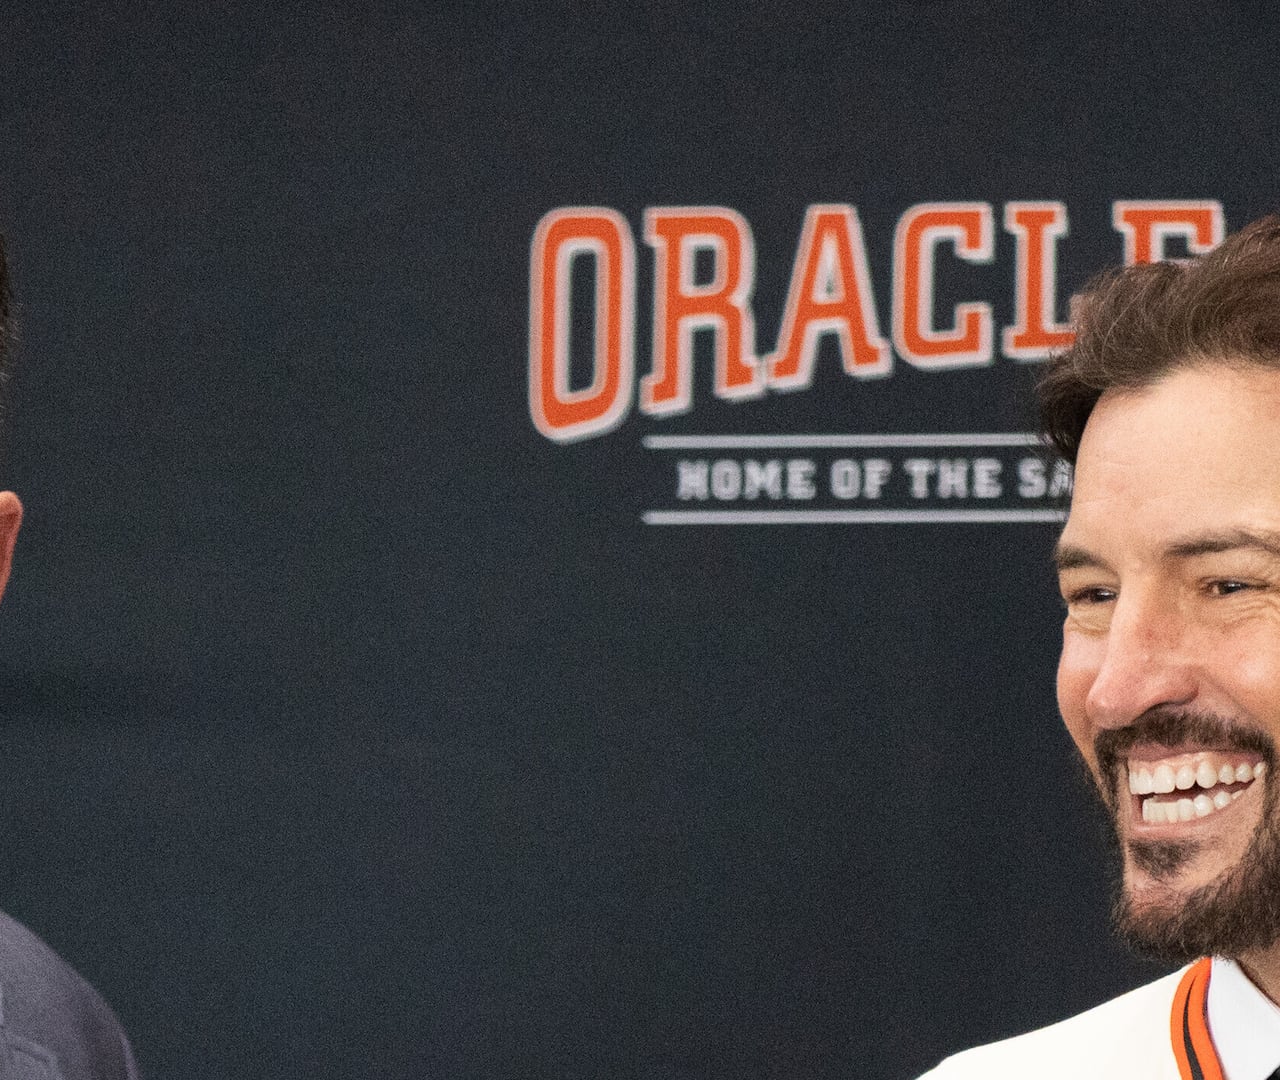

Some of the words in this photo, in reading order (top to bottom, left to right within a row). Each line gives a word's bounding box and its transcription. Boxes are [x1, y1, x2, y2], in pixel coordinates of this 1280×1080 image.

[677, 458, 817, 501] HOME
[829, 457, 893, 500] OF
[904, 457, 1003, 500] THE
[1018, 457, 1074, 500] SA
